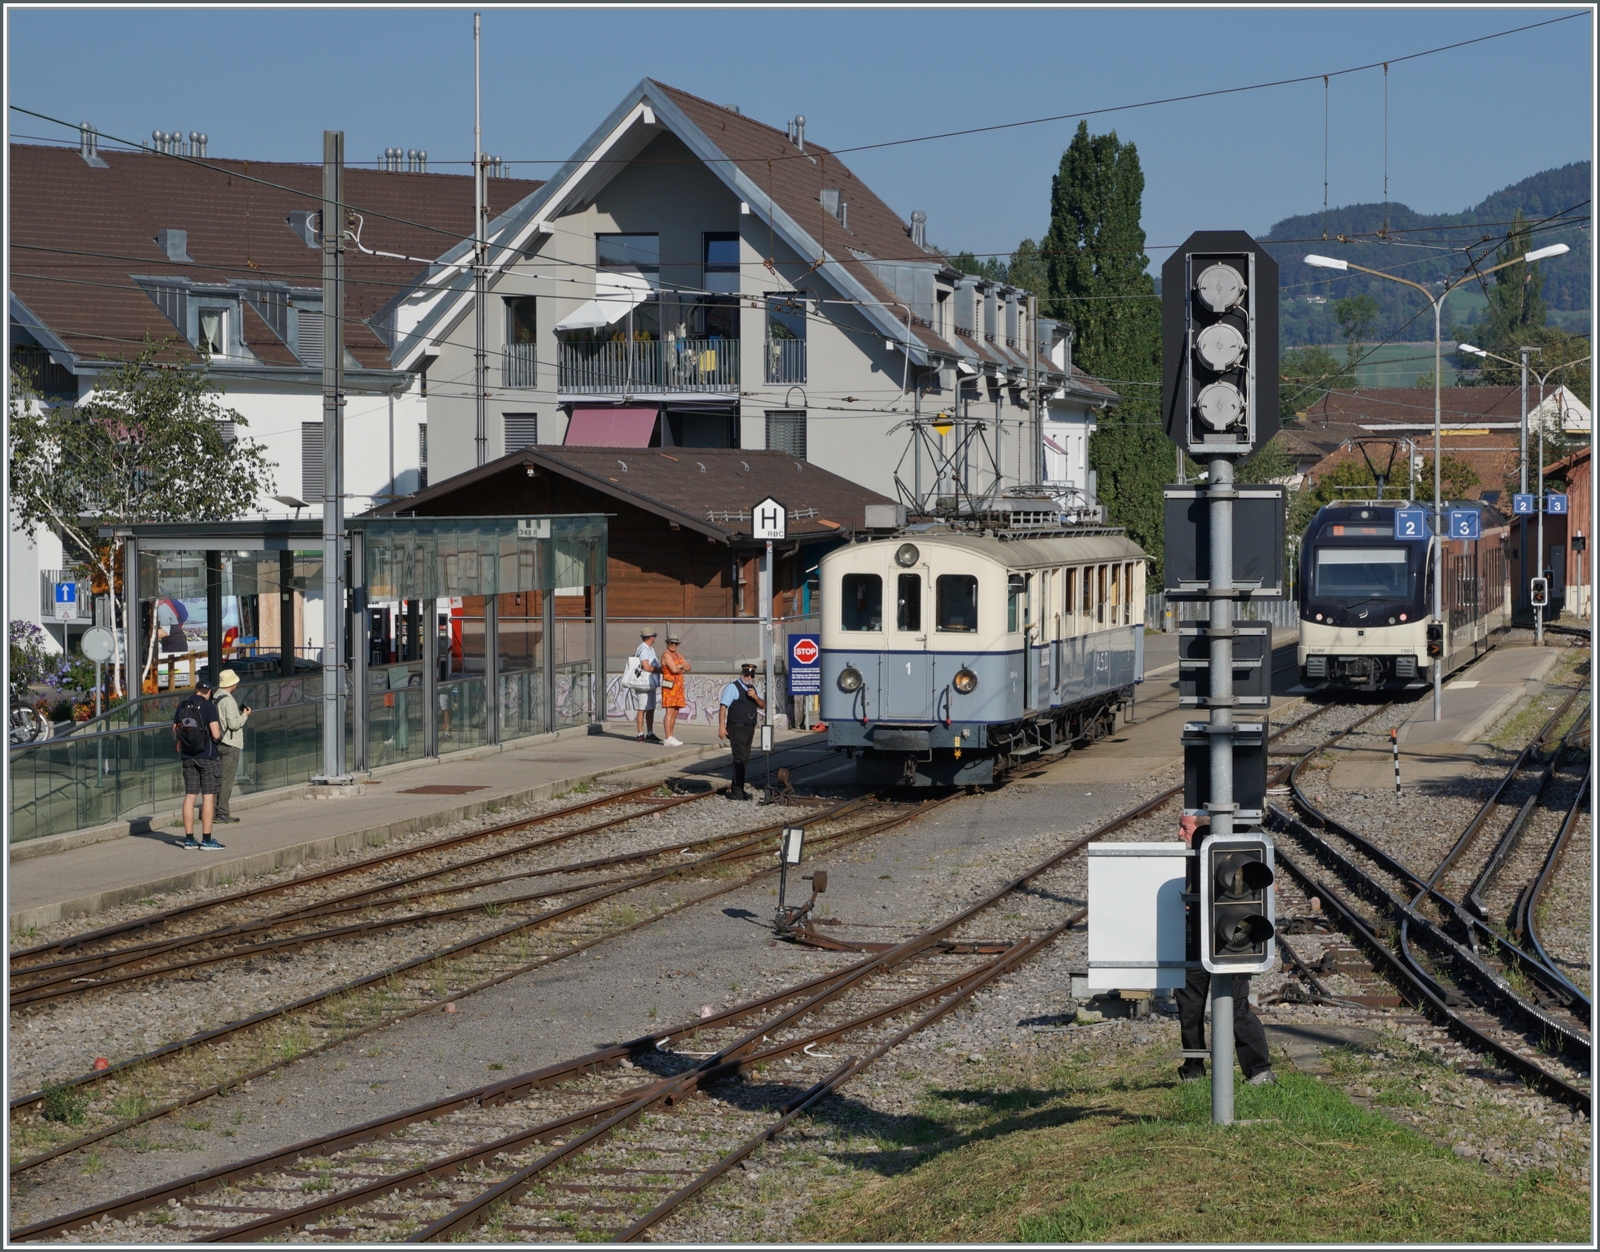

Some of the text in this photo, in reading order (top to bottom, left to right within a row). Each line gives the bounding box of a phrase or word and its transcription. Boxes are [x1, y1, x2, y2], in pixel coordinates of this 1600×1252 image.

[1520, 501, 1527, 511] 2
[1554, 501, 1561, 511] 3
[761, 507, 777, 529] H
[1405, 521, 1415, 535] 2
[1459, 521, 1470, 535] 3
[796, 647, 817, 656] STOP
[905, 661, 912, 676] 1
